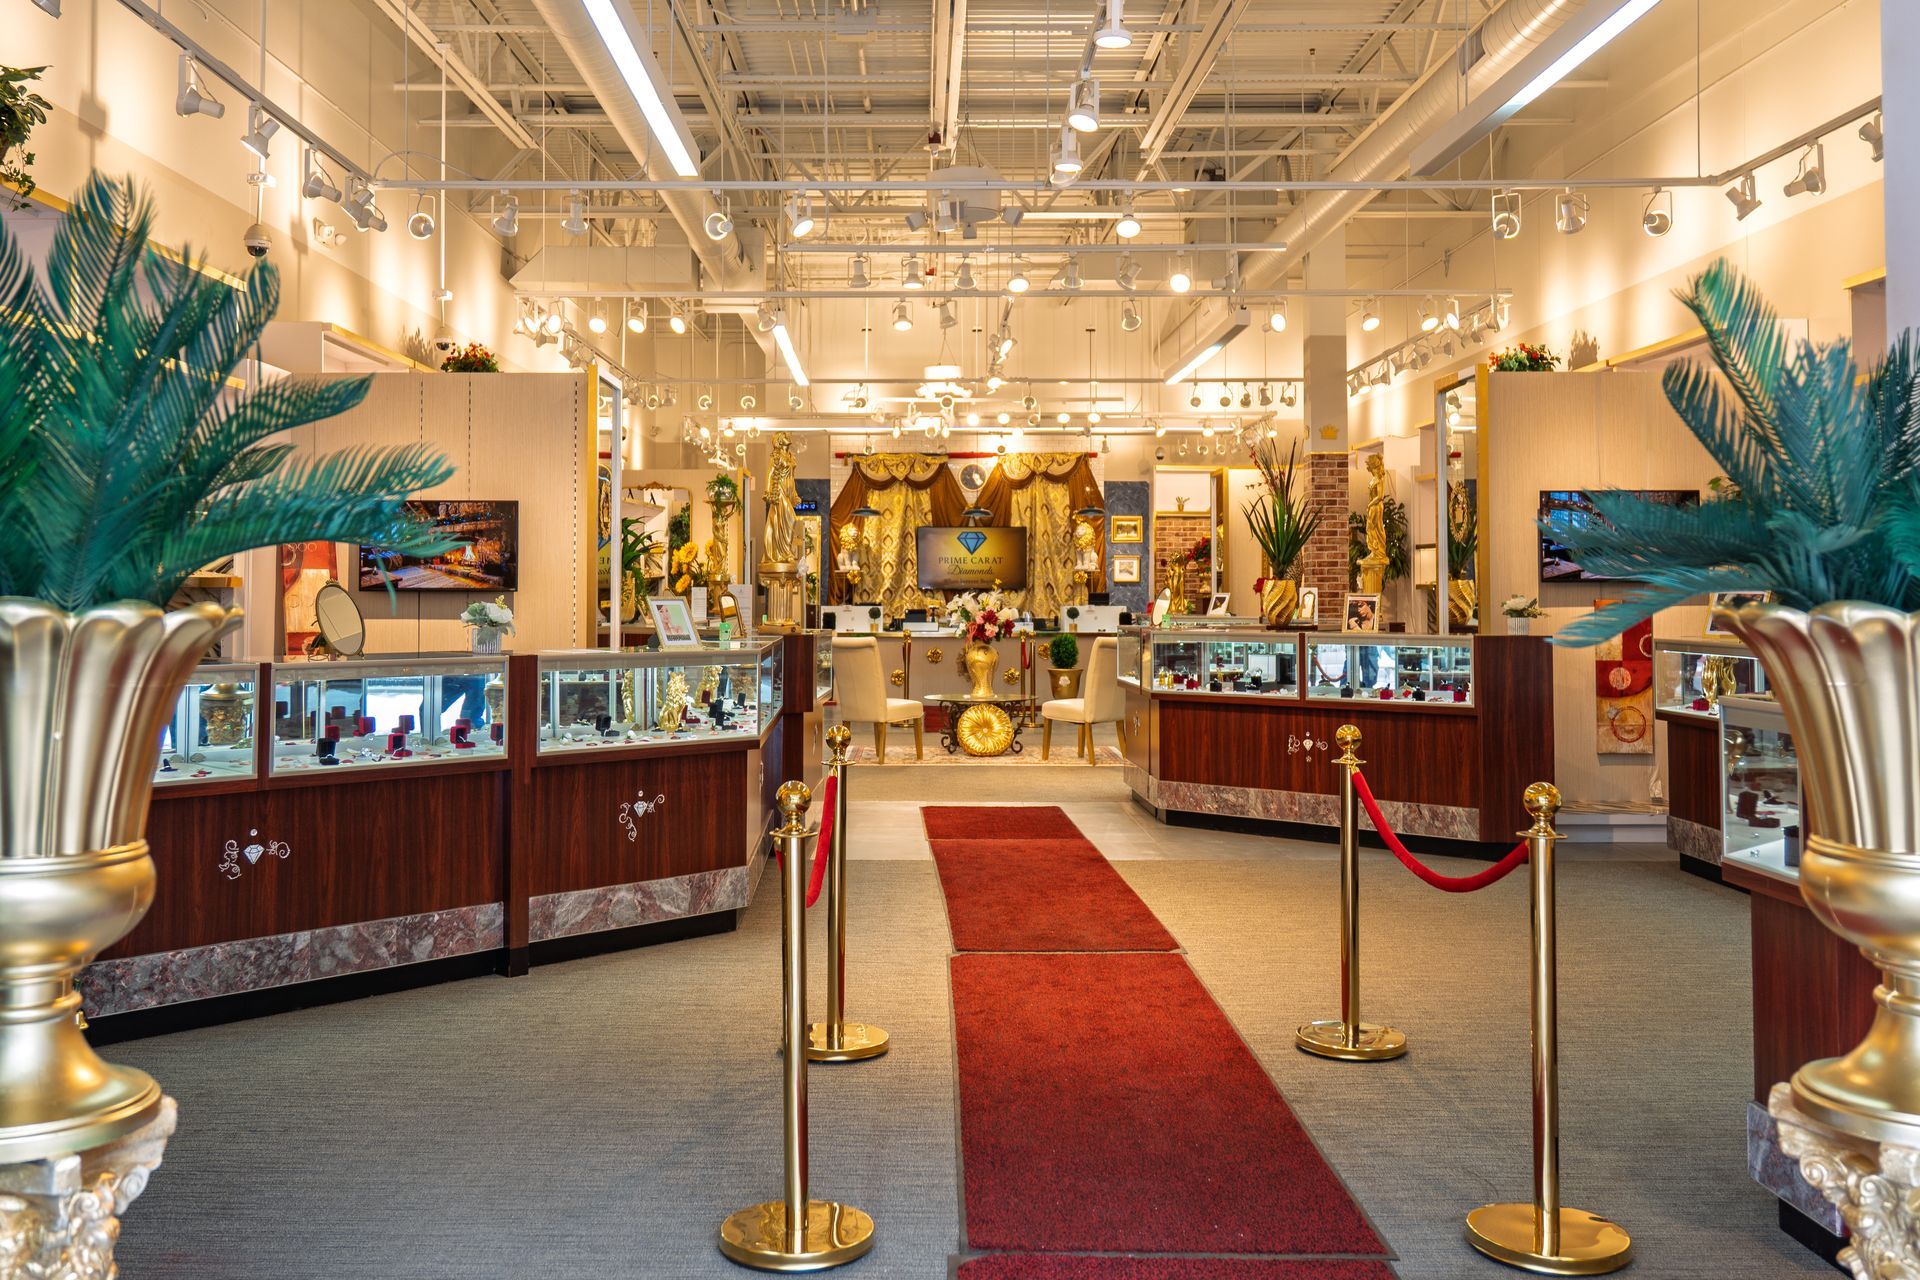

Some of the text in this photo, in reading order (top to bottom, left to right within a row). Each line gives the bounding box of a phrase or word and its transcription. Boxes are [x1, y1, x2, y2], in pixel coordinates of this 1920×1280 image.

[938, 556, 1003, 564] PRIME CARAT
[947, 564, 993, 575] Diamonds
